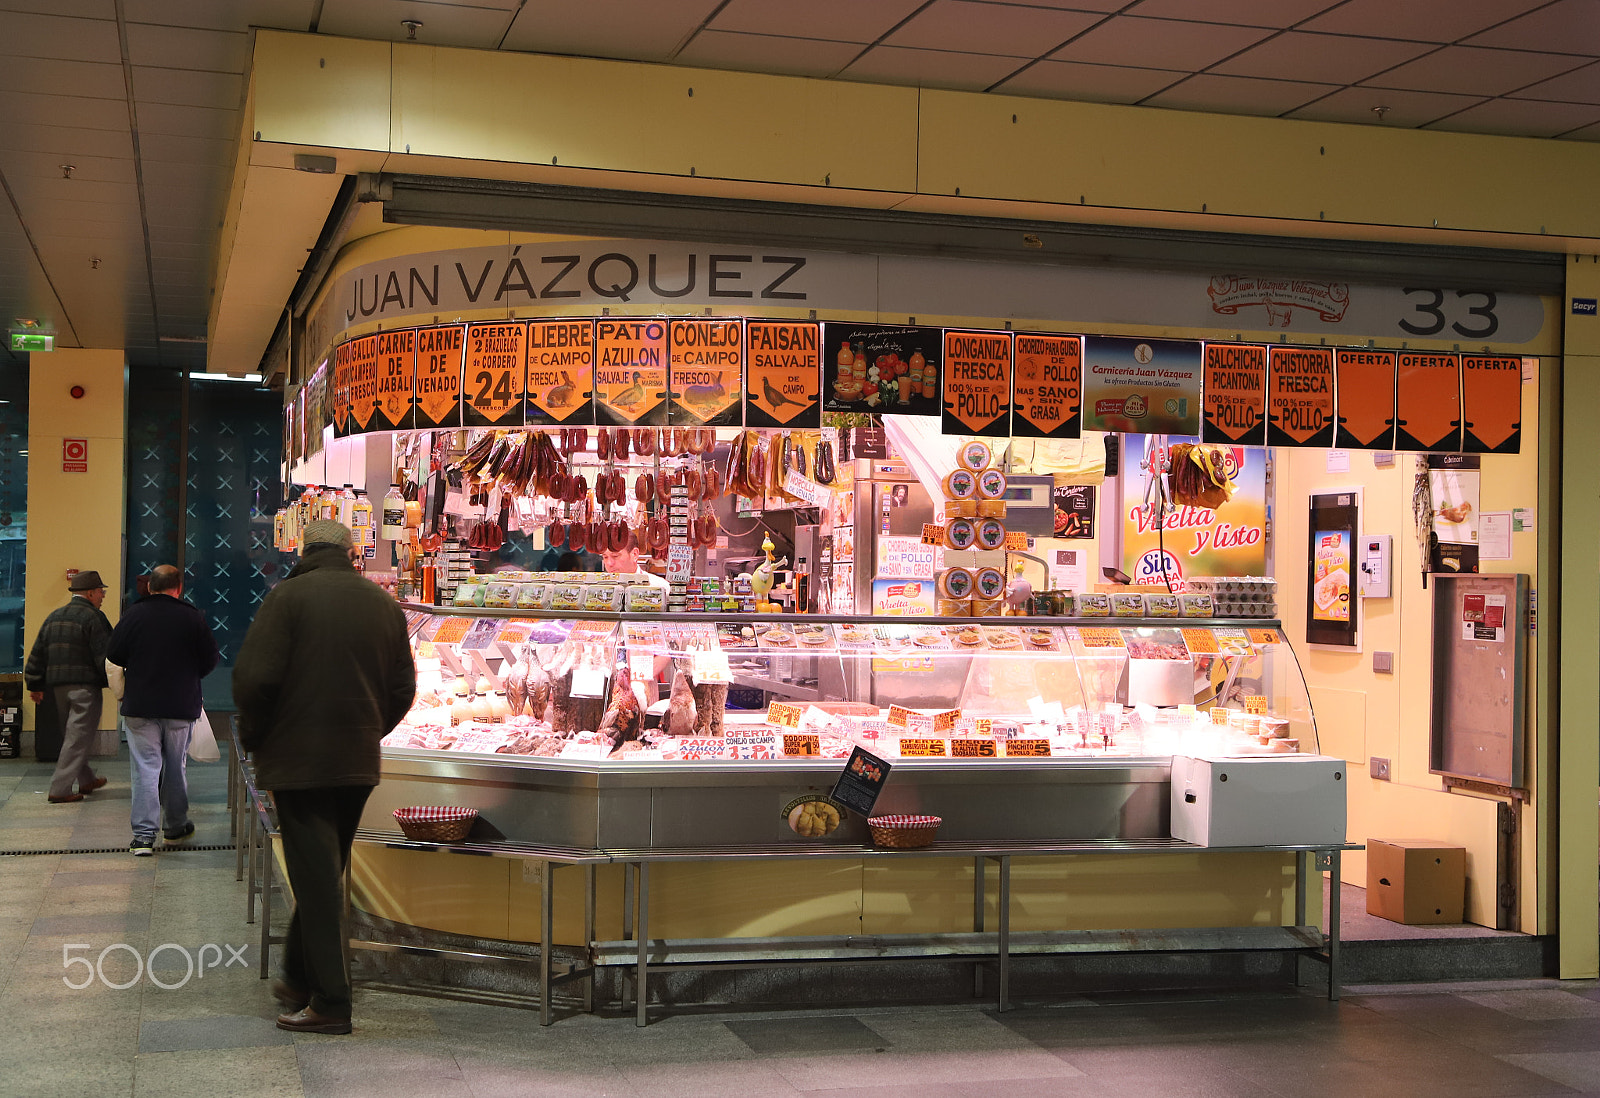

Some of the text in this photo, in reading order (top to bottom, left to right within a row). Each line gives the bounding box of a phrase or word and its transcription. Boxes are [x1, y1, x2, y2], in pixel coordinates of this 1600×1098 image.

[346, 246, 808, 322] JUAN VÁZQUEZ
[1398, 288, 1498, 339] 33
[472, 327, 523, 338] OFERTA
[531, 324, 591, 348] LIEBRE
[599, 323, 664, 340] PATO
[674, 324, 739, 347] CONEJO
[750, 327, 816, 351] FAISAN
[380, 332, 413, 355] CARNE
[420, 329, 460, 352] CARNE
[475, 338, 518, 353] 2 BRAZUELOS
[1018, 338, 1078, 357] CHORIZO PARA GUISO
[353, 339, 375, 361] GALLO
[948, 337, 1008, 360] LONGANIZA
[430, 354, 446, 373] DE
[482, 355, 517, 369] CORDERO
[530, 351, 591, 366] DE CAMPO
[602, 348, 660, 366] AZULON
[672, 351, 739, 365] DE CAMPO
[755, 354, 816, 368] SALVAJE
[1208, 348, 1264, 370] SALCHICHA
[1273, 353, 1331, 374] CHISTORRA
[1340, 354, 1391, 366] OFERTA
[1402, 356, 1455, 368] OFERTA
[351, 362, 375, 383] CAMPERO
[389, 357, 402, 376] DE
[953, 362, 1005, 381] FRESCA
[1092, 365, 1193, 380] Carnicería Juan Vázquez
[1466, 359, 1518, 371] OFERTA
[530, 371, 559, 385] FRESCA
[597, 371, 629, 384] SALVAJE
[674, 372, 710, 385] FRESCO
[1044, 366, 1078, 382] POLLO
[1212, 372, 1260, 390] PICANTONA
[351, 381, 375, 400] FRESCO
[379, 376, 413, 393] JABALI
[418, 376, 457, 393] VENADO
[474, 371, 512, 407] 24
[783, 384, 805, 395] CAMPO
[949, 384, 964, 393] 100
[966, 384, 973, 393] %
[1128, 378, 1154, 386] Productos
[1163, 380, 1180, 388] Gluten
[1278, 376, 1328, 393] FRESCA
[1016, 386, 1078, 398] MAS SANO
[1208, 395, 1222, 404] 100
[1223, 396, 1231, 404] %
[958, 394, 999, 417] POLLO
[1273, 398, 1288, 407] 100
[1289, 399, 1297, 407] %
[1030, 405, 1060, 420] GRASA
[1216, 404, 1255, 428] POLLO
[1282, 408, 1323, 430] POLLO
[791, 475, 815, 493] MORCILLA
[796, 487, 815, 503] VENADO
[1190, 524, 1260, 556] y listo
[901, 553, 932, 562] POLLO
[1142, 553, 1172, 575] Sin
[888, 564, 901, 576] SANO
[914, 564, 932, 576] GRASA
[879, 599, 909, 610] Vuelta
[908, 606, 926, 614] listo
[770, 702, 801, 714] CODORNIZ
[784, 712, 793, 726] 1
[726, 730, 775, 738] OFERTA
[680, 739, 725, 747] PATOS
[801, 741, 812, 755] 1
[929, 743, 946, 754] 5
[979, 744, 995, 756] 5
[1034, 743, 1051, 754] 5
